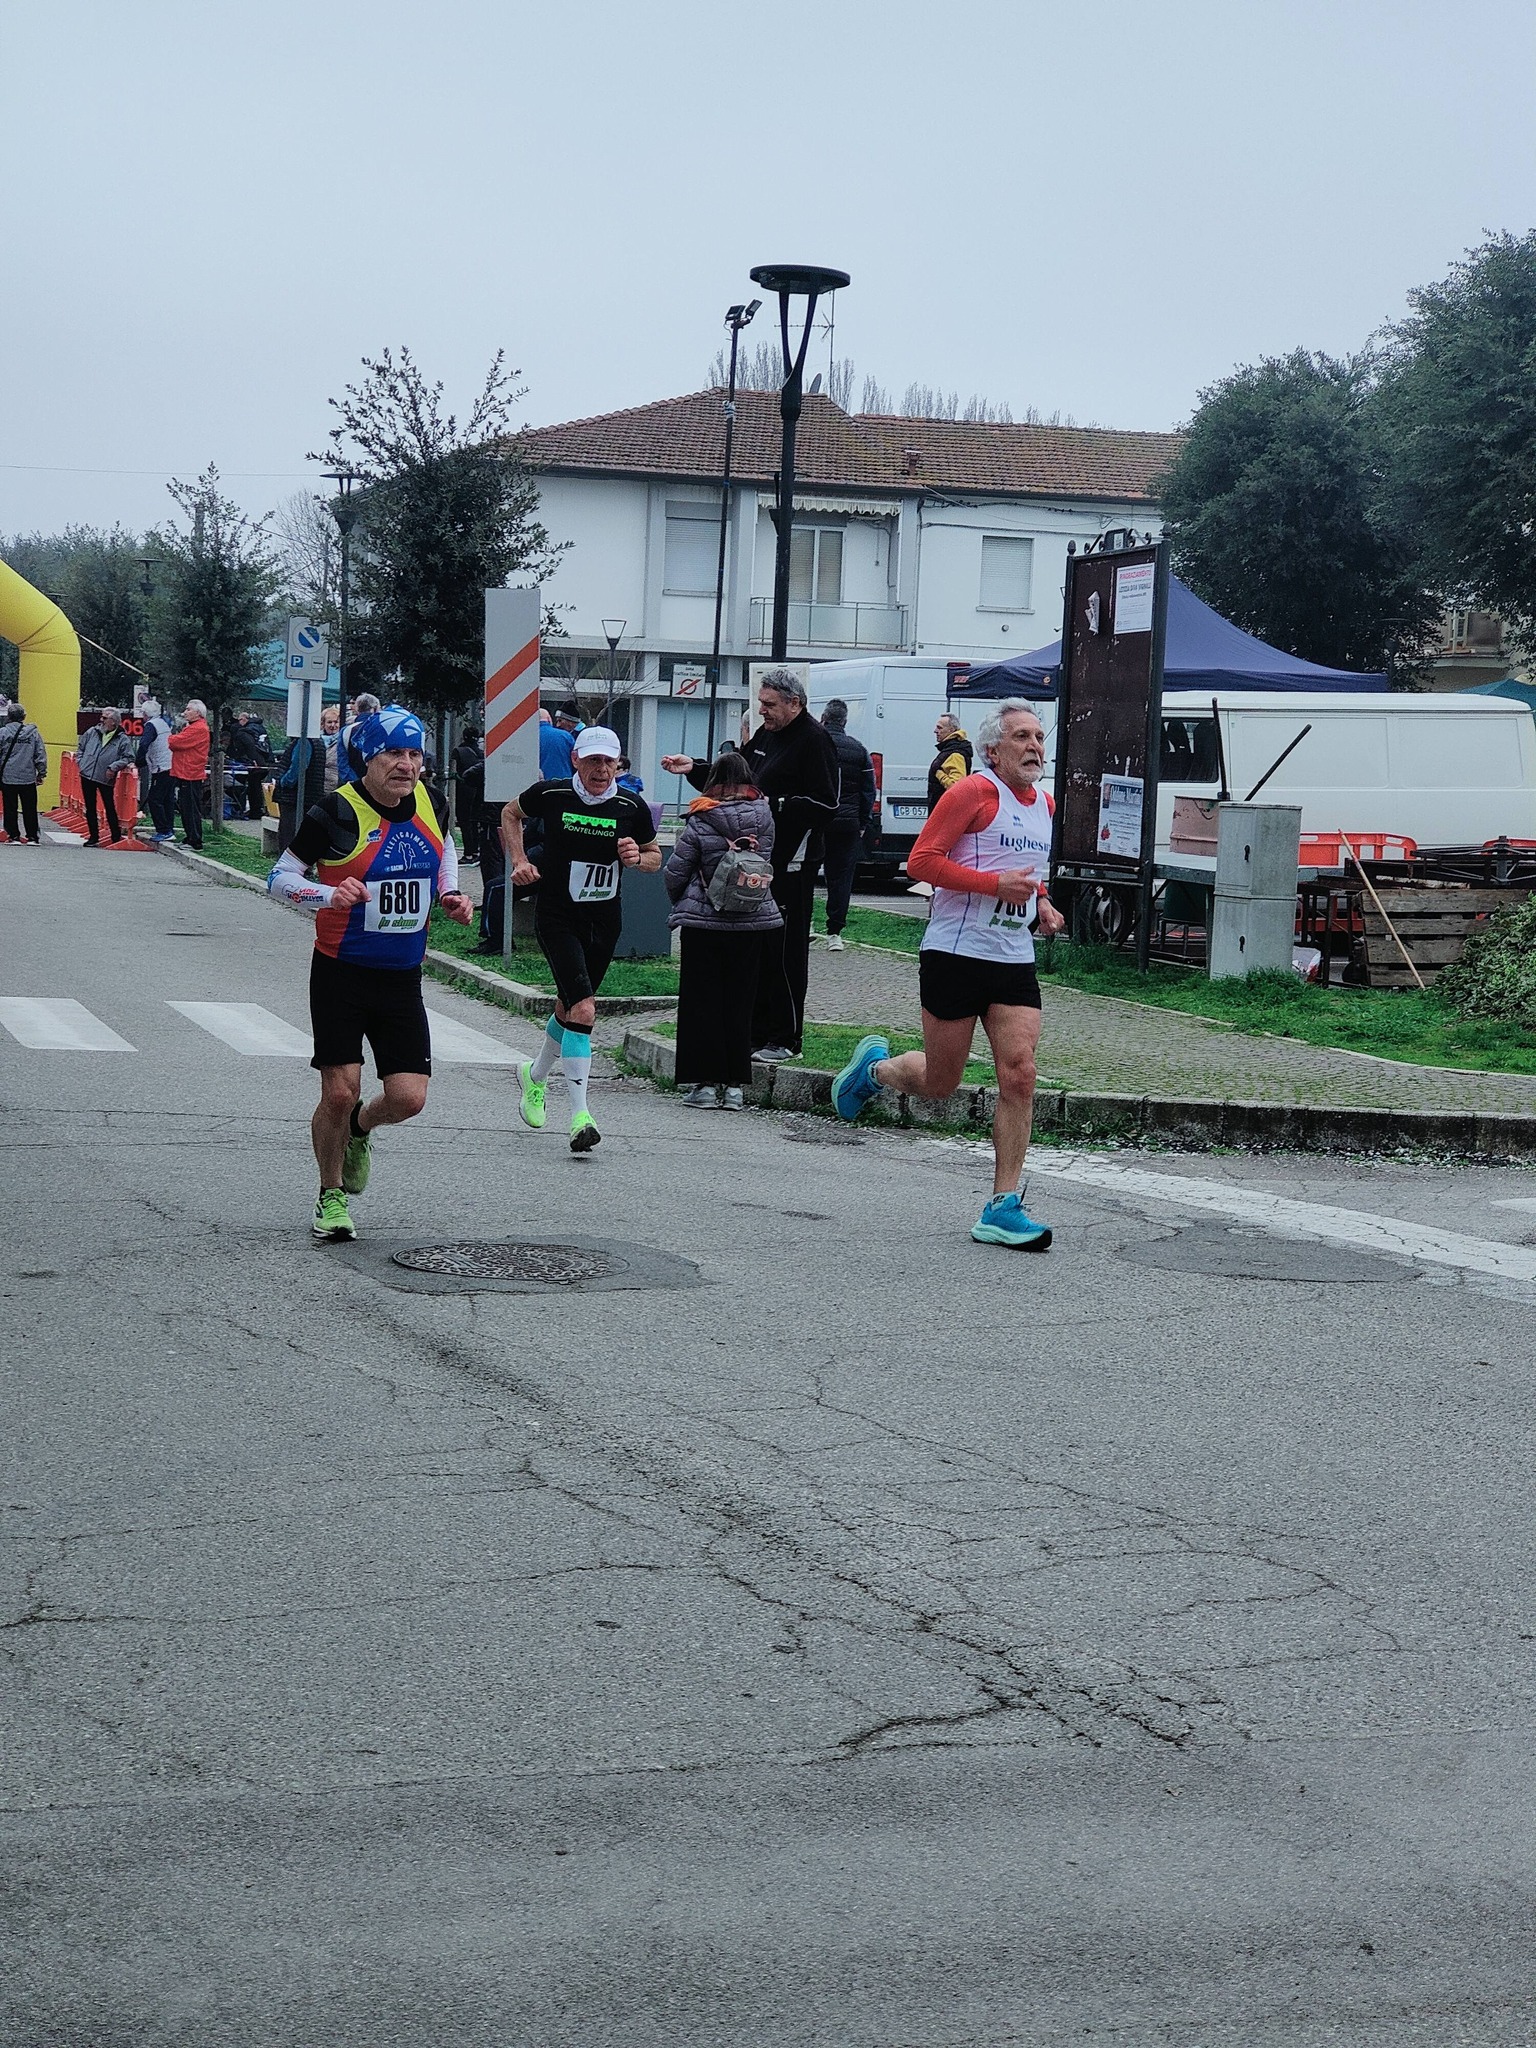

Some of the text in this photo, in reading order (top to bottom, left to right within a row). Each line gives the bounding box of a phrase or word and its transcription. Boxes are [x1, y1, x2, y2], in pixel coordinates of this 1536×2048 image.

[563, 825, 615, 838] PONTELUNGO
[584, 864, 614, 888] 701
[379, 881, 420, 915] 680
